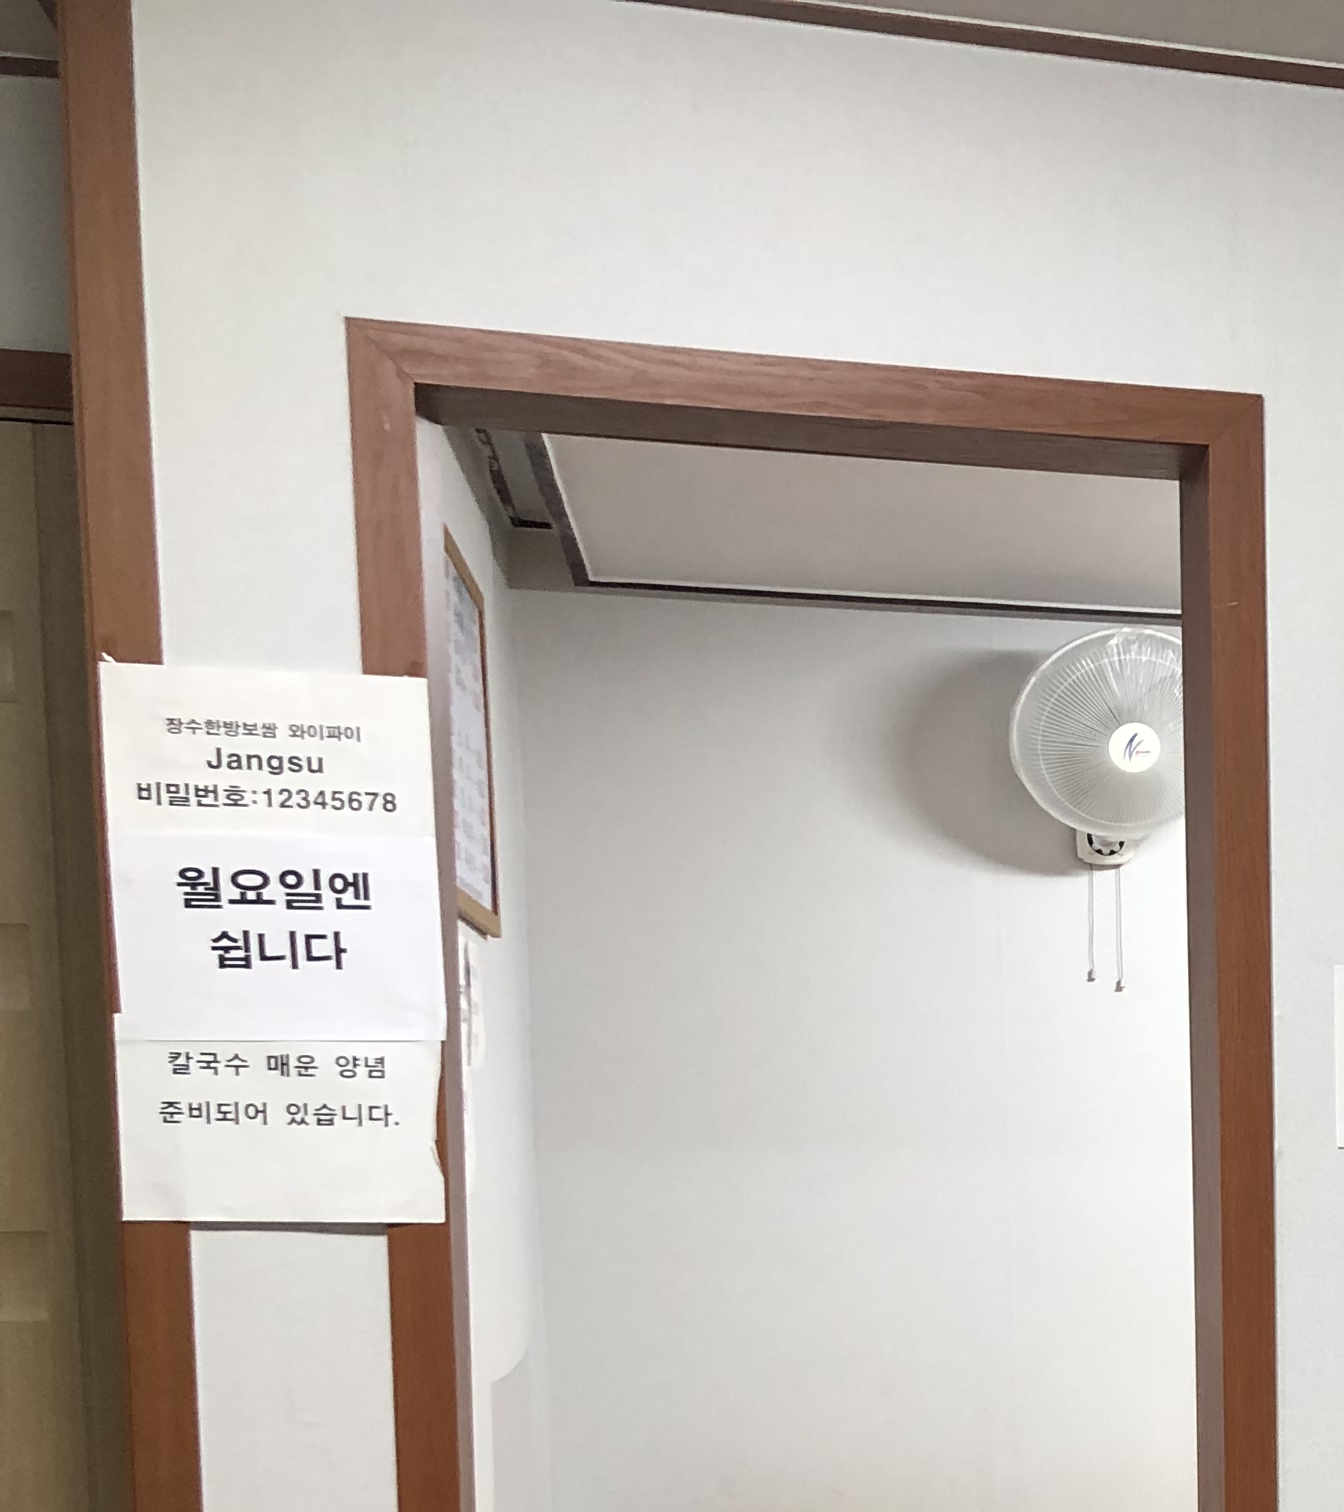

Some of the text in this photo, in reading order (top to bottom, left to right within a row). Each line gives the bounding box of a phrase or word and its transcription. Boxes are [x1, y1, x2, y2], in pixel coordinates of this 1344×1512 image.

[164, 717, 362, 743] 장수한방보쌈 와이파이
[206, 747, 326, 776] Jangsu
[175, 866, 373, 911] 월요일엔
[209, 930, 349, 970] 쉽니다
[167, 1051, 388, 1080] 칼국수 매운 양념
[157, 1101, 402, 1128] 준비되어 있습니다.
